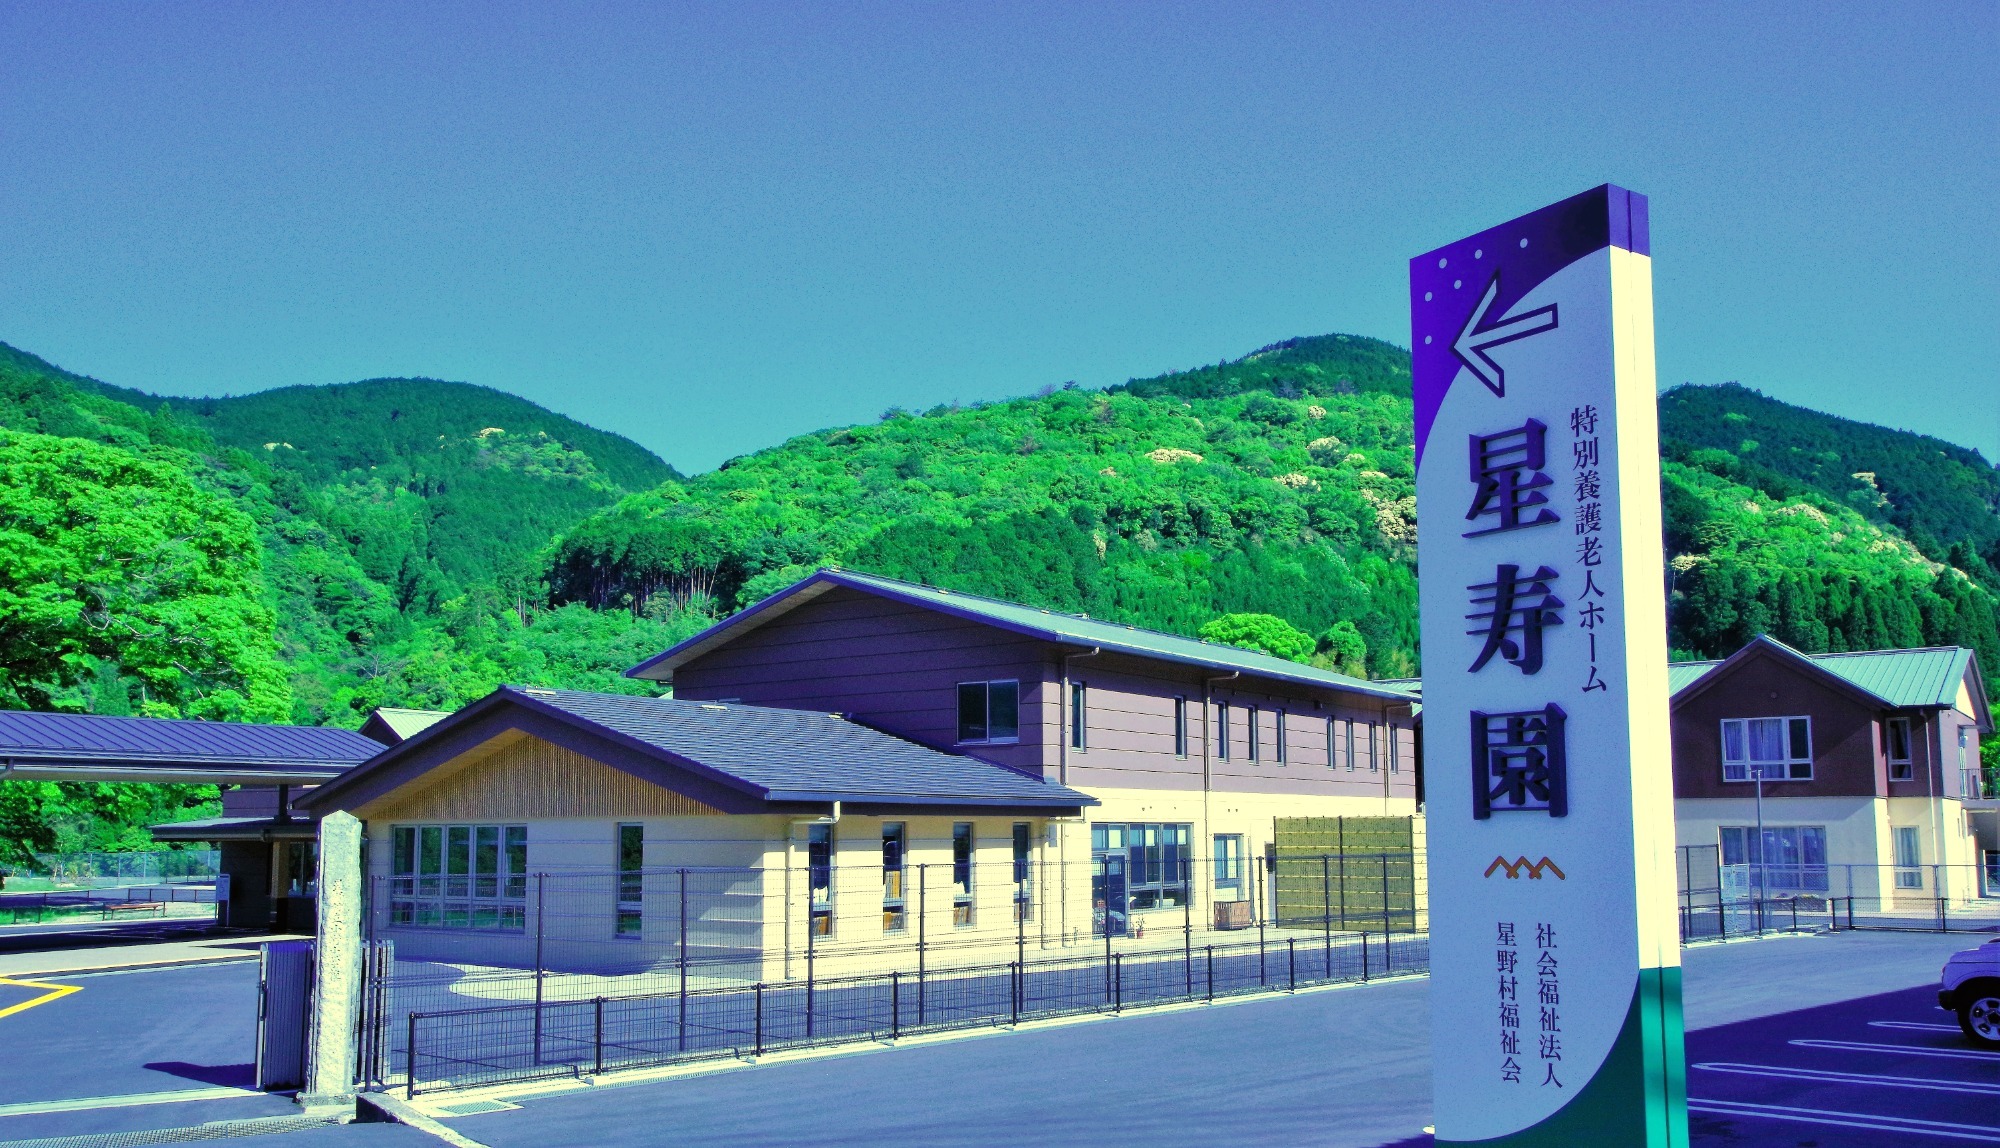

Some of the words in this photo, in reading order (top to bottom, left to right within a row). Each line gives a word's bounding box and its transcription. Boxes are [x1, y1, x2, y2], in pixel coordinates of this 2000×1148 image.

[1461, 416, 1568, 821] 星寿園
[1570, 404, 1607, 693] 特別養護老人ホーム
[1496, 921, 1521, 1085] 星野村福祉会
[1535, 922, 1563, 1089] 社会福祉法人
